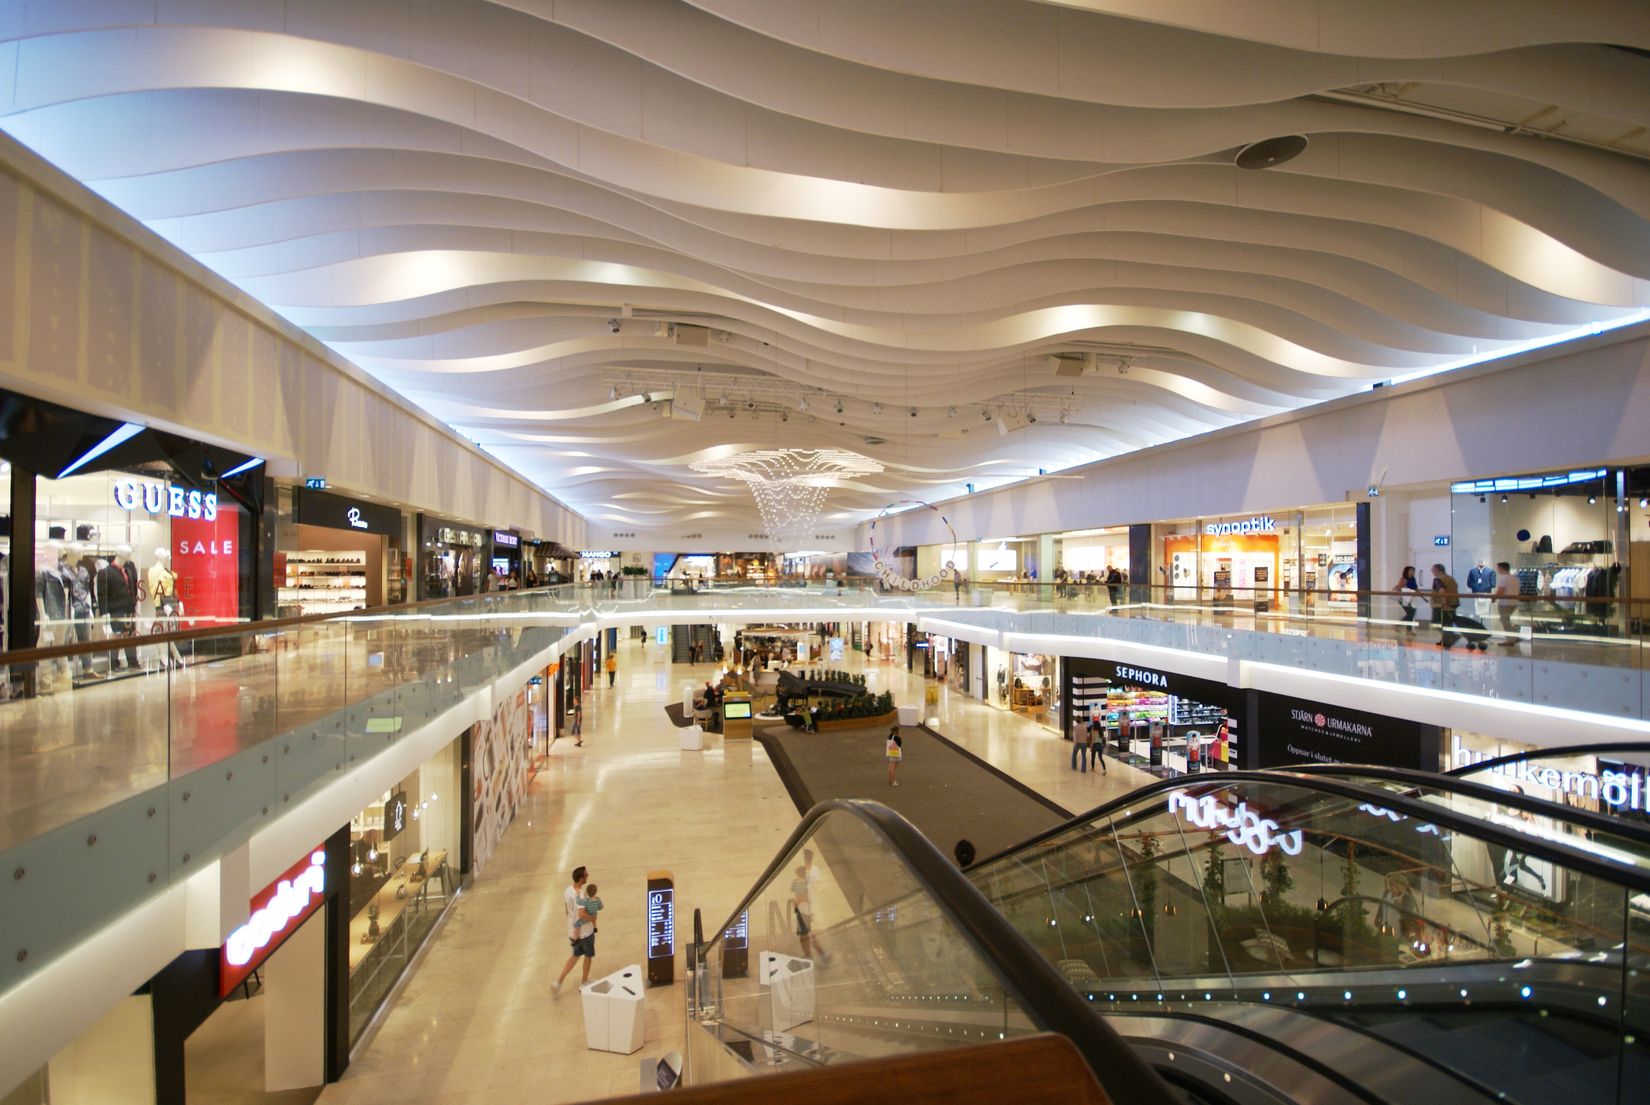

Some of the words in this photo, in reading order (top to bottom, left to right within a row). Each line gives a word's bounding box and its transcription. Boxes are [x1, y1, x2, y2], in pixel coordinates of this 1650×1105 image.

[114, 479, 217, 521] GUESS
[1206, 516, 1276, 536] synoptik
[180, 540, 233, 555] SALE
[874, 561, 955, 590] CHILDHOOD
[1116, 666, 1168, 688] SEPHORA
[1327, 717, 1372, 738] URMAKARNA
